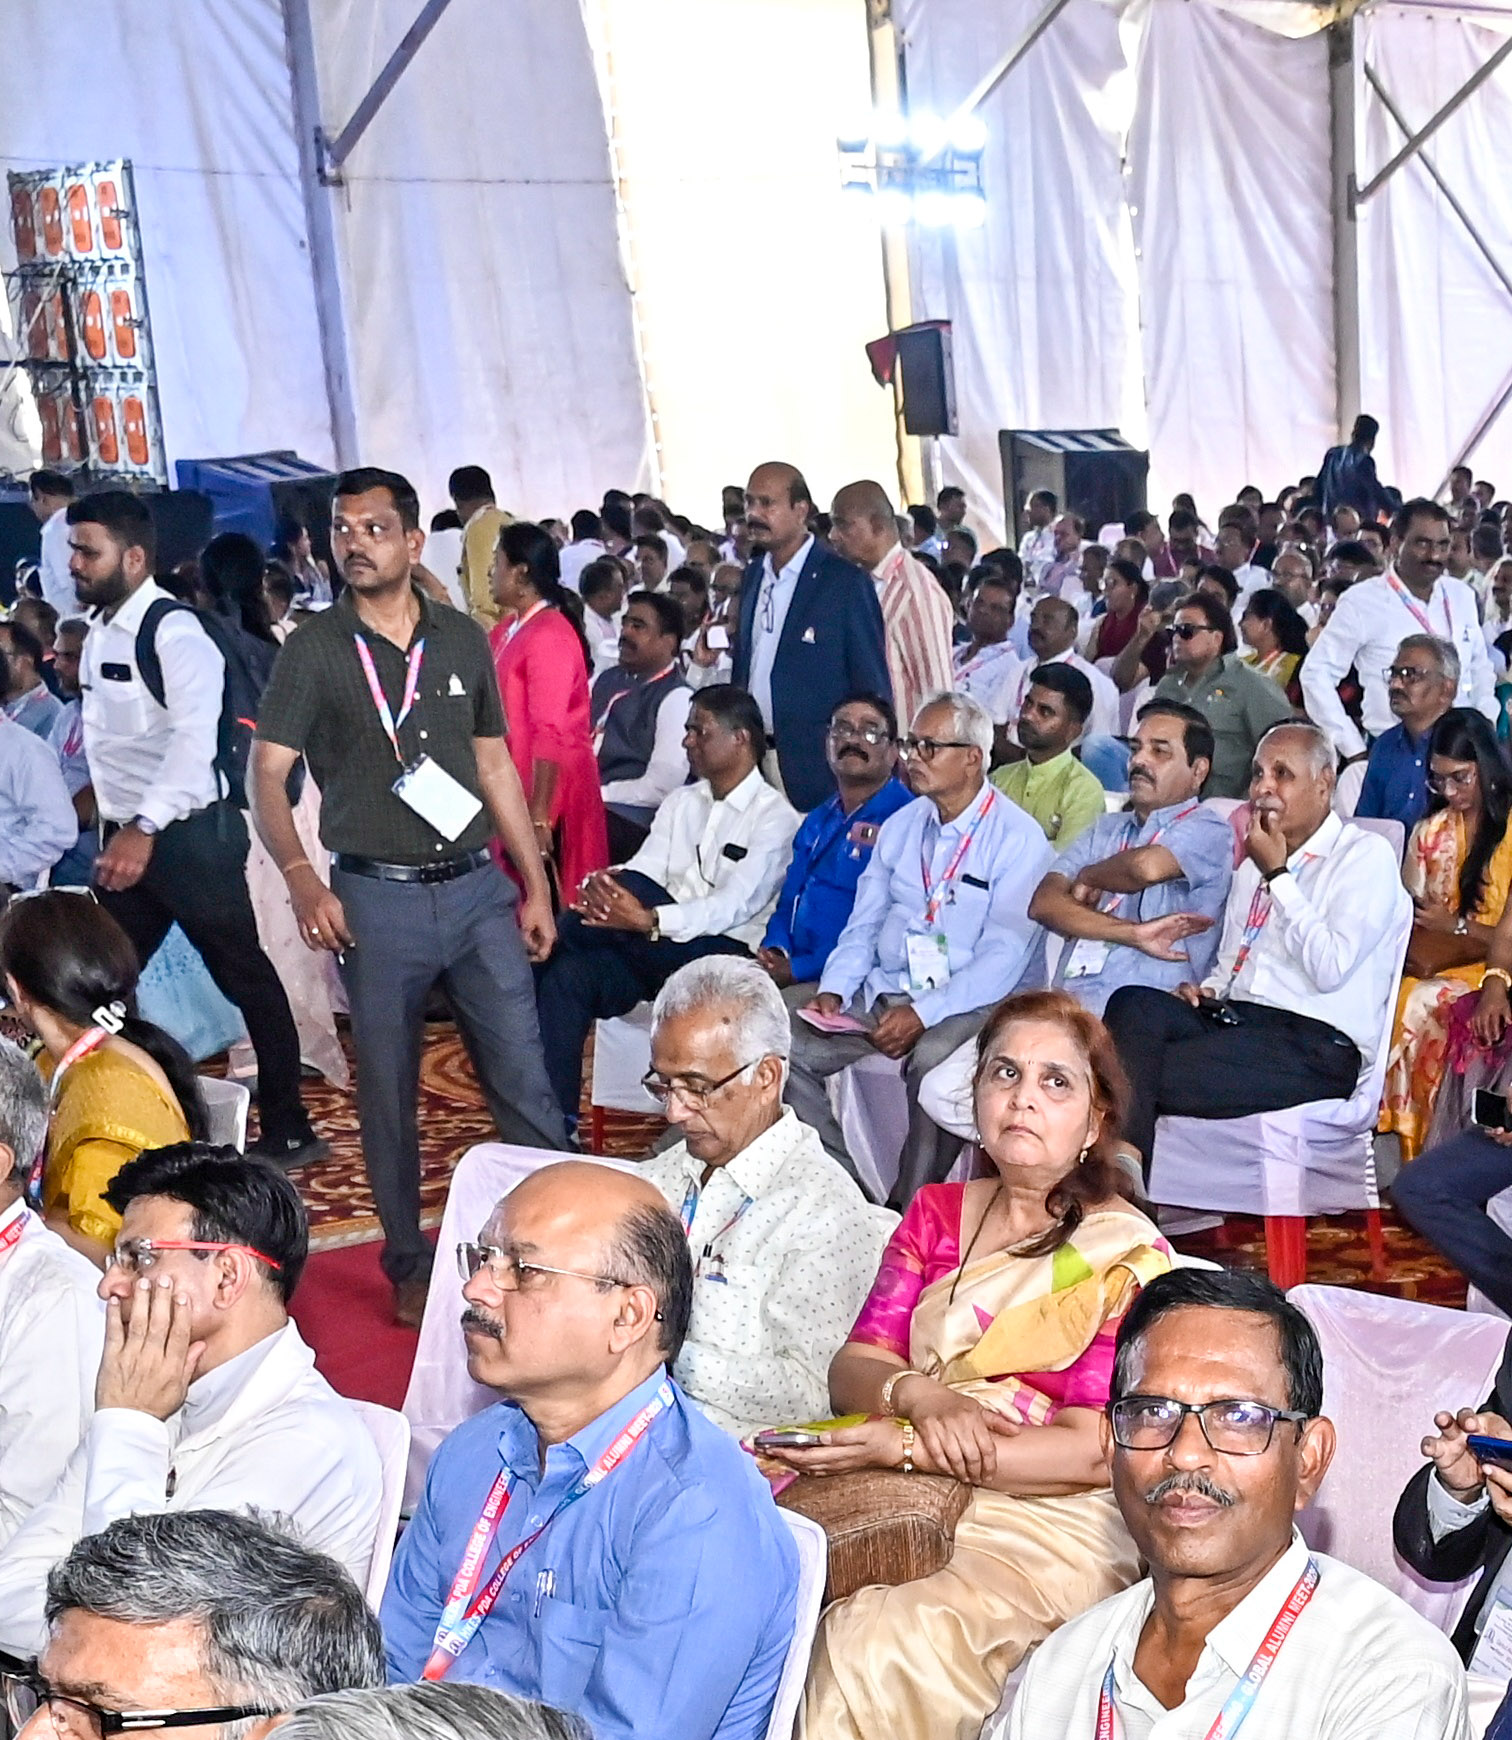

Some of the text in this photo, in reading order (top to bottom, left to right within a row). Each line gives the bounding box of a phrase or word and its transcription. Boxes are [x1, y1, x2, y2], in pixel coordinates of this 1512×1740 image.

[602, 1436, 631, 1475] ALUMNI
[452, 1576, 468, 1601] PDA
[464, 1533, 486, 1579] COLLEGE
[477, 1517, 492, 1534] OF
[478, 1591, 493, 1617] PDA
[489, 1556, 514, 1597] COLLEGE
[1242, 1653, 1274, 1697] GLOBAL
[1267, 1609, 1296, 1656] ALUMNI
